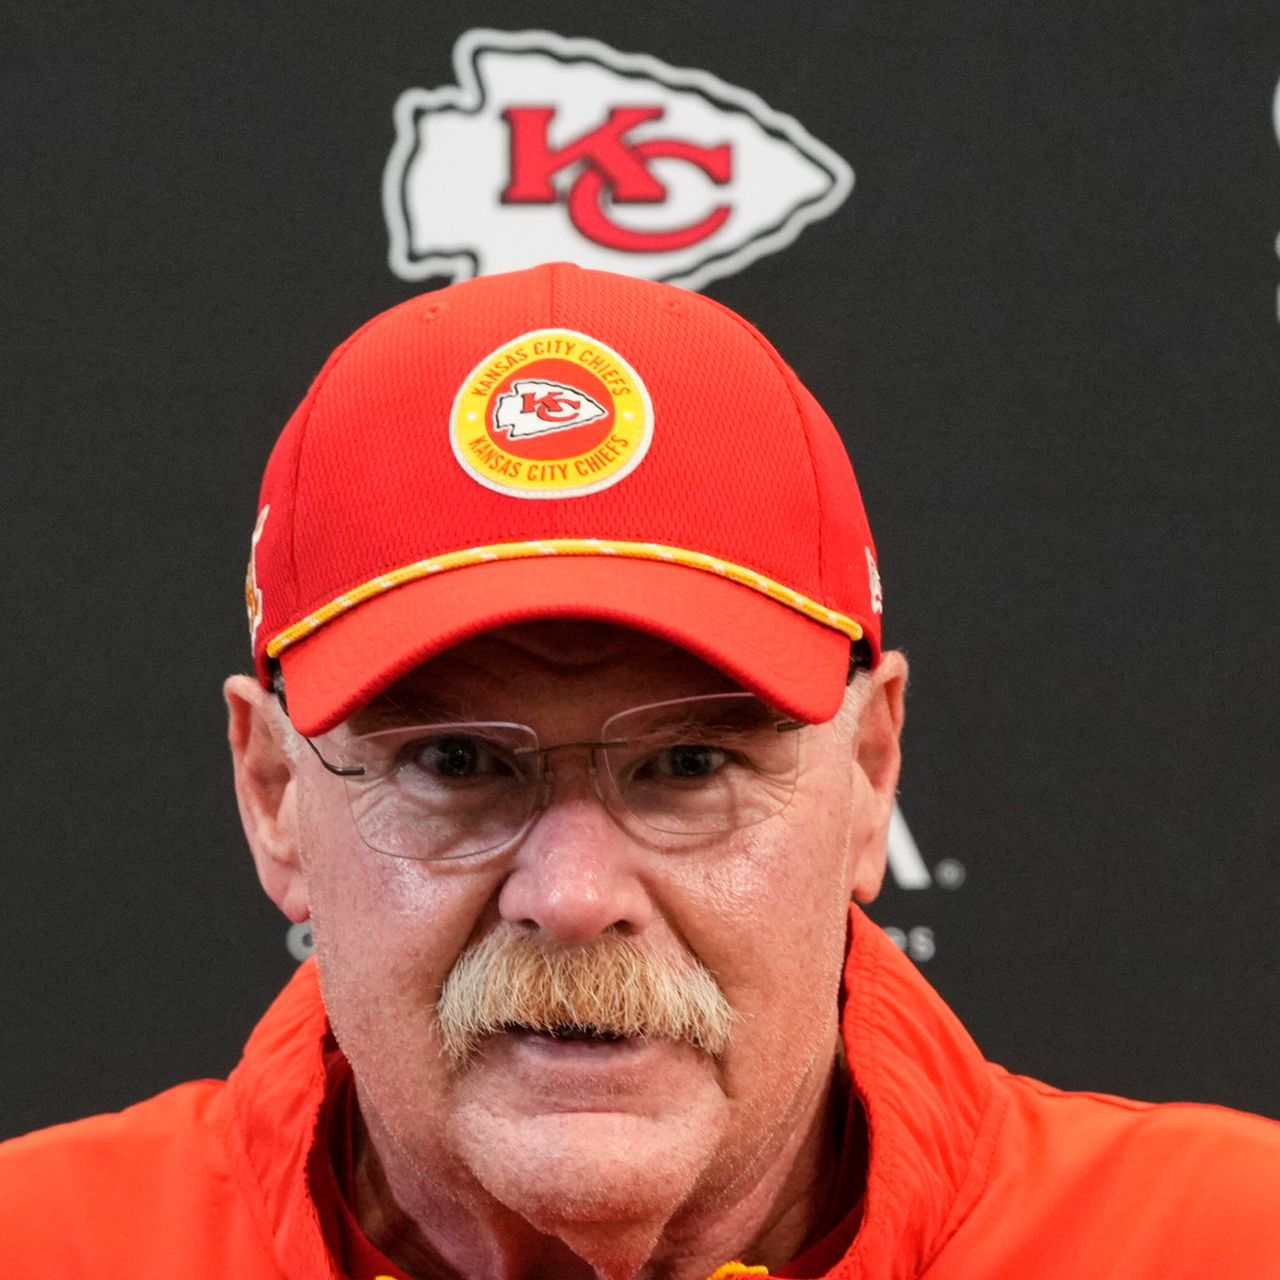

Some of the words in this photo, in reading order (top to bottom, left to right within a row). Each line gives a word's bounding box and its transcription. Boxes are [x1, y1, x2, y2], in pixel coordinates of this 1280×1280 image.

[502, 105, 734, 254] KC
[471, 348, 528, 397] KANSAS
[533, 339, 577, 356] CITY
[578, 349, 631, 397] CHIEFS
[520, 391, 581, 423] KC
[468, 435, 523, 479] KANSAS
[527, 463, 569, 482] CITY
[574, 434, 630, 477] CHIEFS
